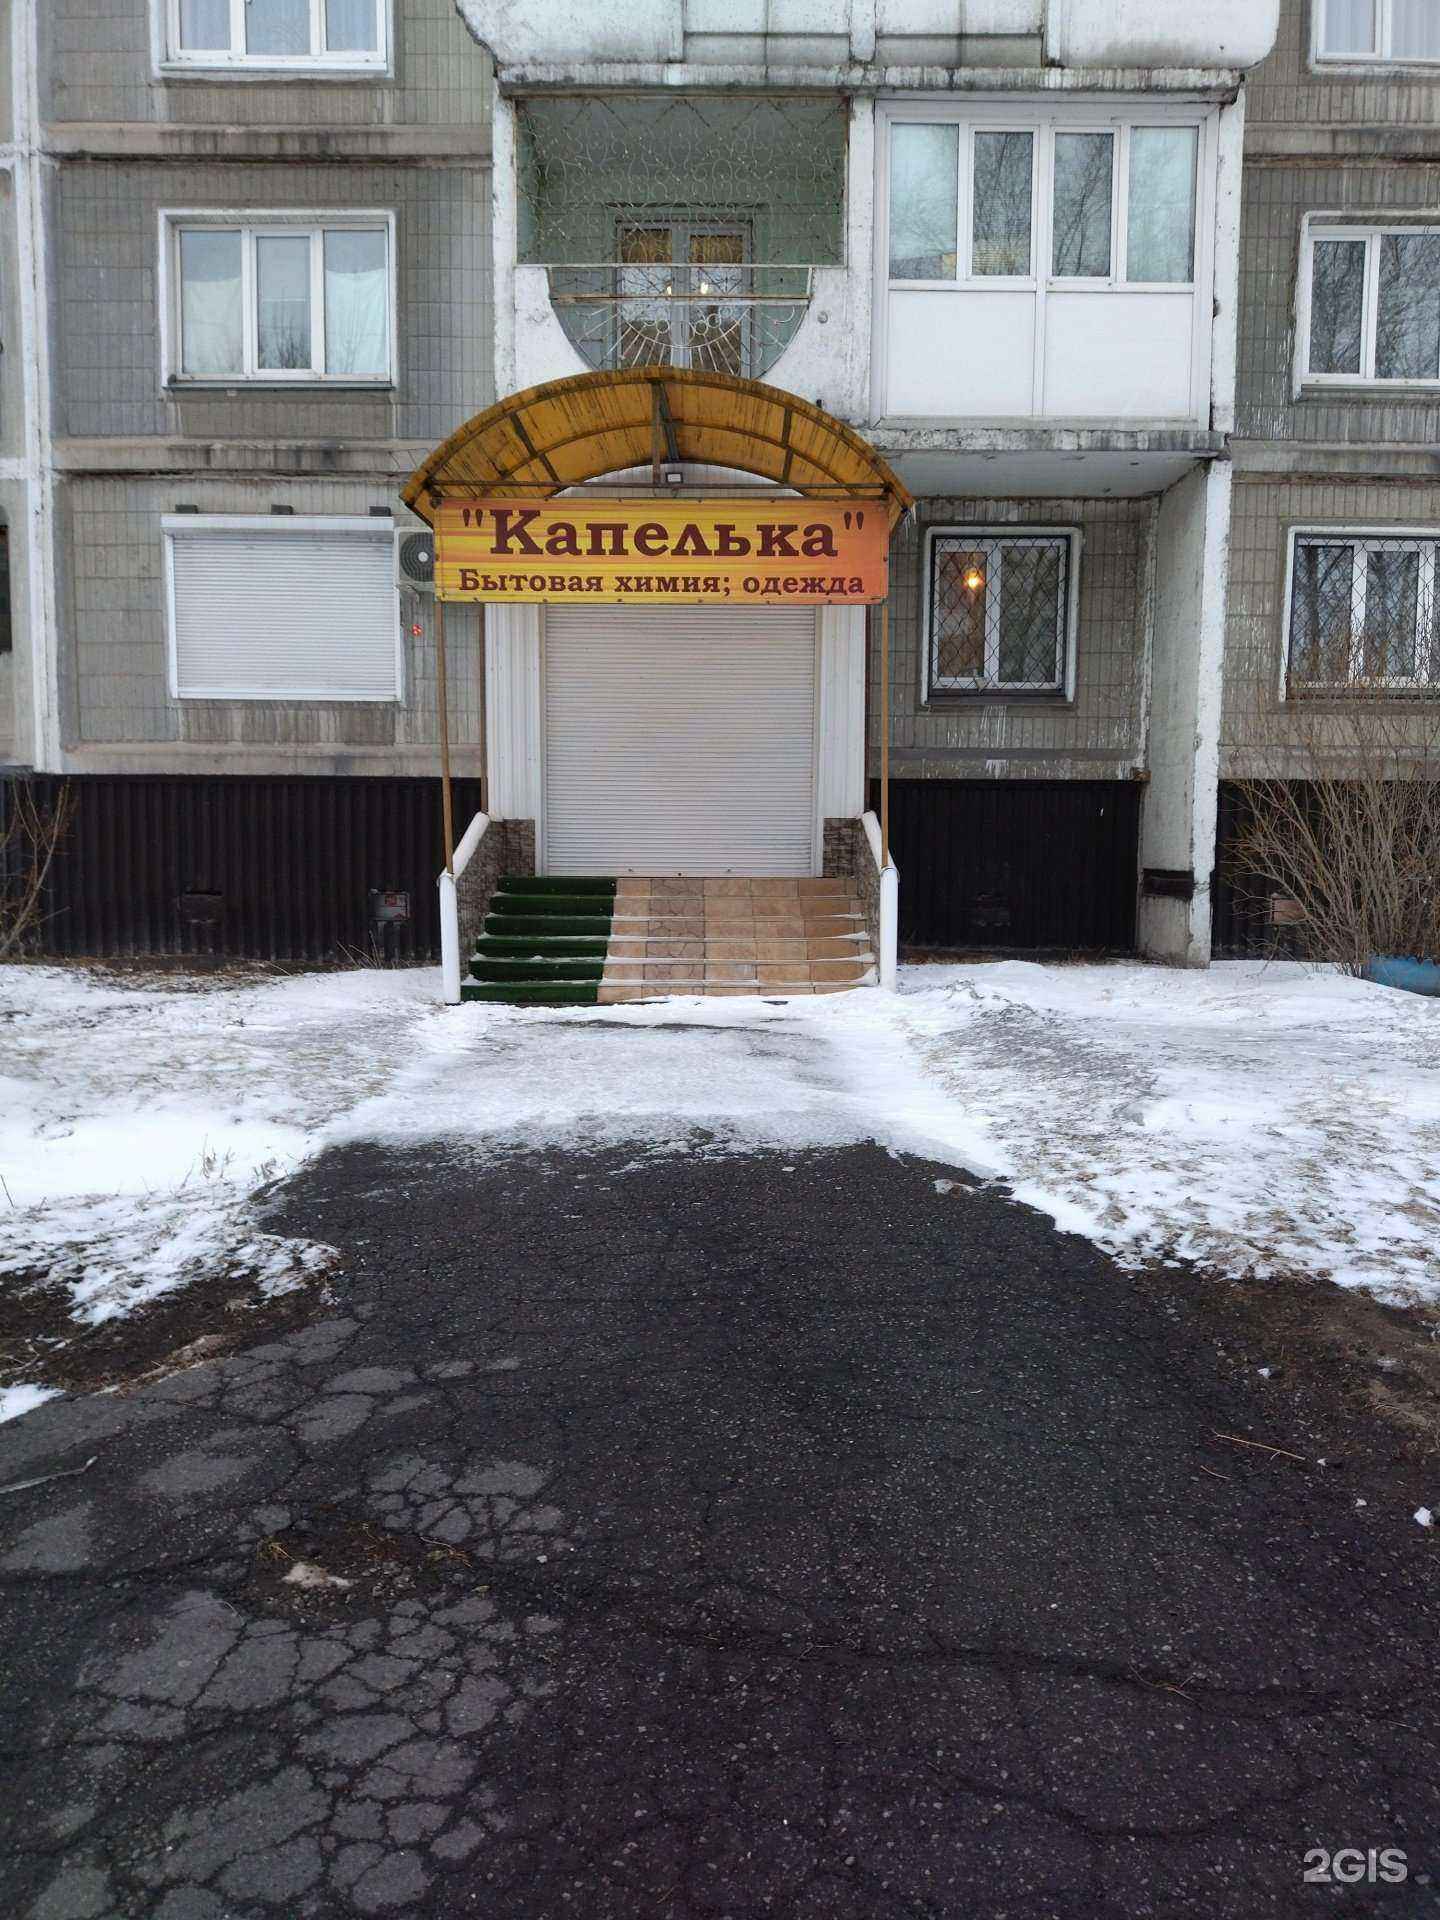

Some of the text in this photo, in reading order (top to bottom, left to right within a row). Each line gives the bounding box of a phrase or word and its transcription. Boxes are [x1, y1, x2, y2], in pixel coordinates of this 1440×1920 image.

[462, 508, 864, 558] "Капелька"
[459, 568, 865, 597] Бытовая химия; одежда
